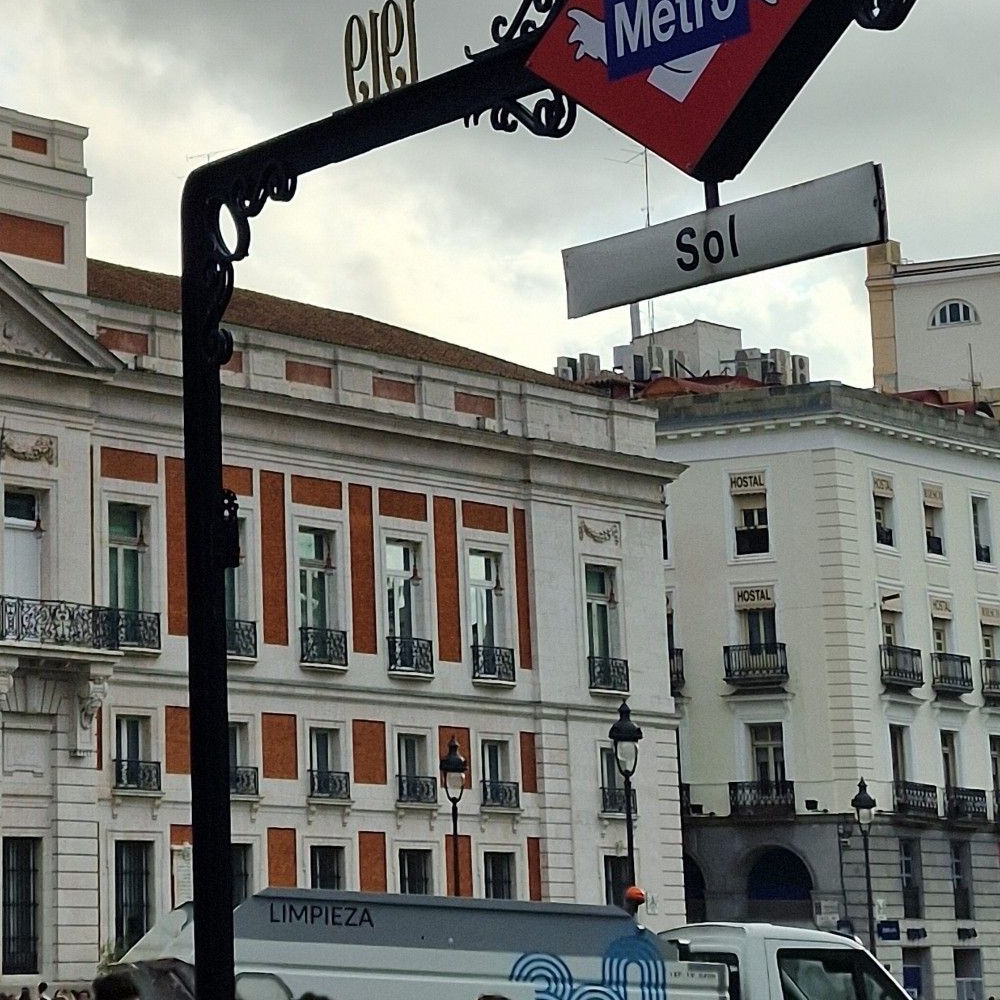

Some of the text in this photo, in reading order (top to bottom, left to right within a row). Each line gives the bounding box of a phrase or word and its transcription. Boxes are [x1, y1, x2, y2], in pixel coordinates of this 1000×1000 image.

[675, 214, 739, 272] Sol
[730, 475, 764, 488] HOSTAL
[737, 589, 771, 602] HOSTAL
[270, 903, 374, 928] LIMPIEZA
